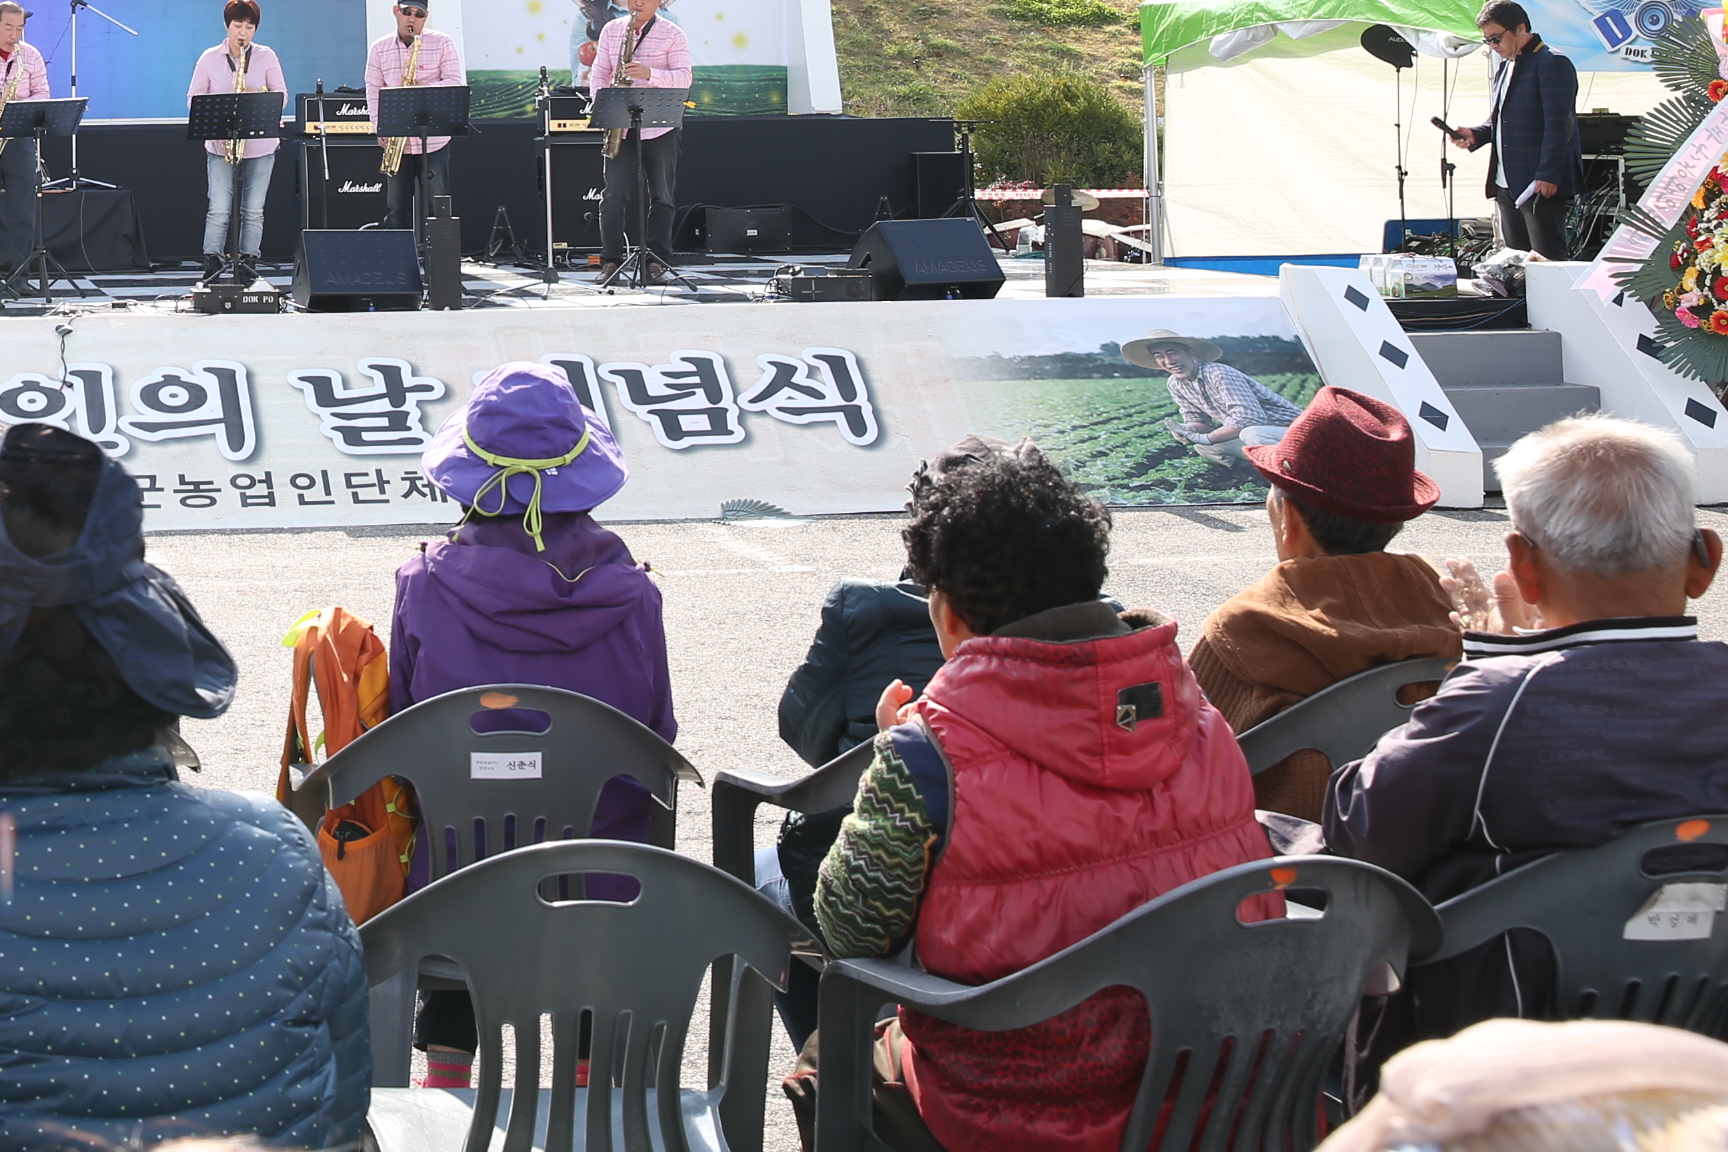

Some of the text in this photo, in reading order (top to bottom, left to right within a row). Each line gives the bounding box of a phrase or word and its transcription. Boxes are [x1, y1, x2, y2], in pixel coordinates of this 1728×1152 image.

[337, 180, 383, 193] Marshall
[915, 259, 989, 274] AMADEUS
[324, 272, 407, 286] AMADEUS
[298, 363, 435, 447] 날
